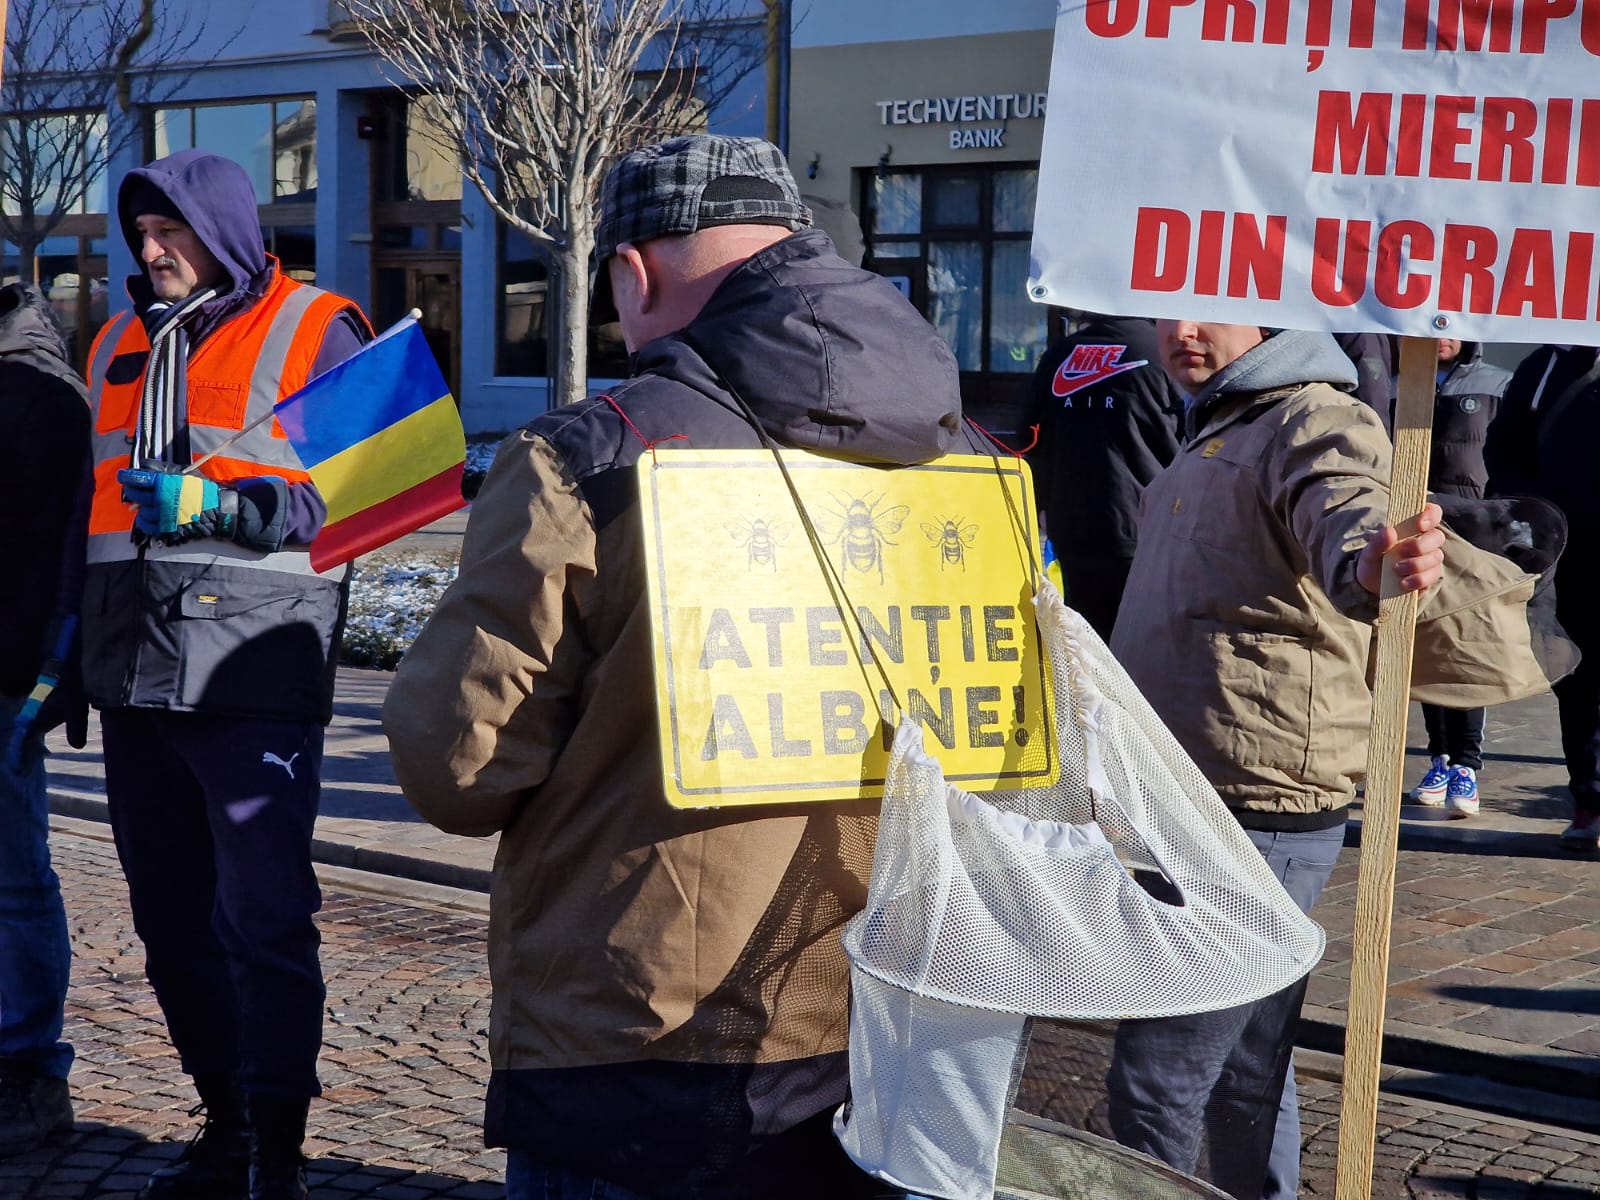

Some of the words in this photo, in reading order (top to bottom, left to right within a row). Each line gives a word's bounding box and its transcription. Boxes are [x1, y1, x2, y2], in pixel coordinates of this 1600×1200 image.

[950, 129, 1003, 149] BANK
[1131, 207, 1287, 300] DIN
[1311, 217, 1600, 323] UCRAI
[1064, 344, 1127, 373] NIKE
[699, 605, 1018, 685] ATENȚIE
[701, 686, 1029, 761] ALBINE!
